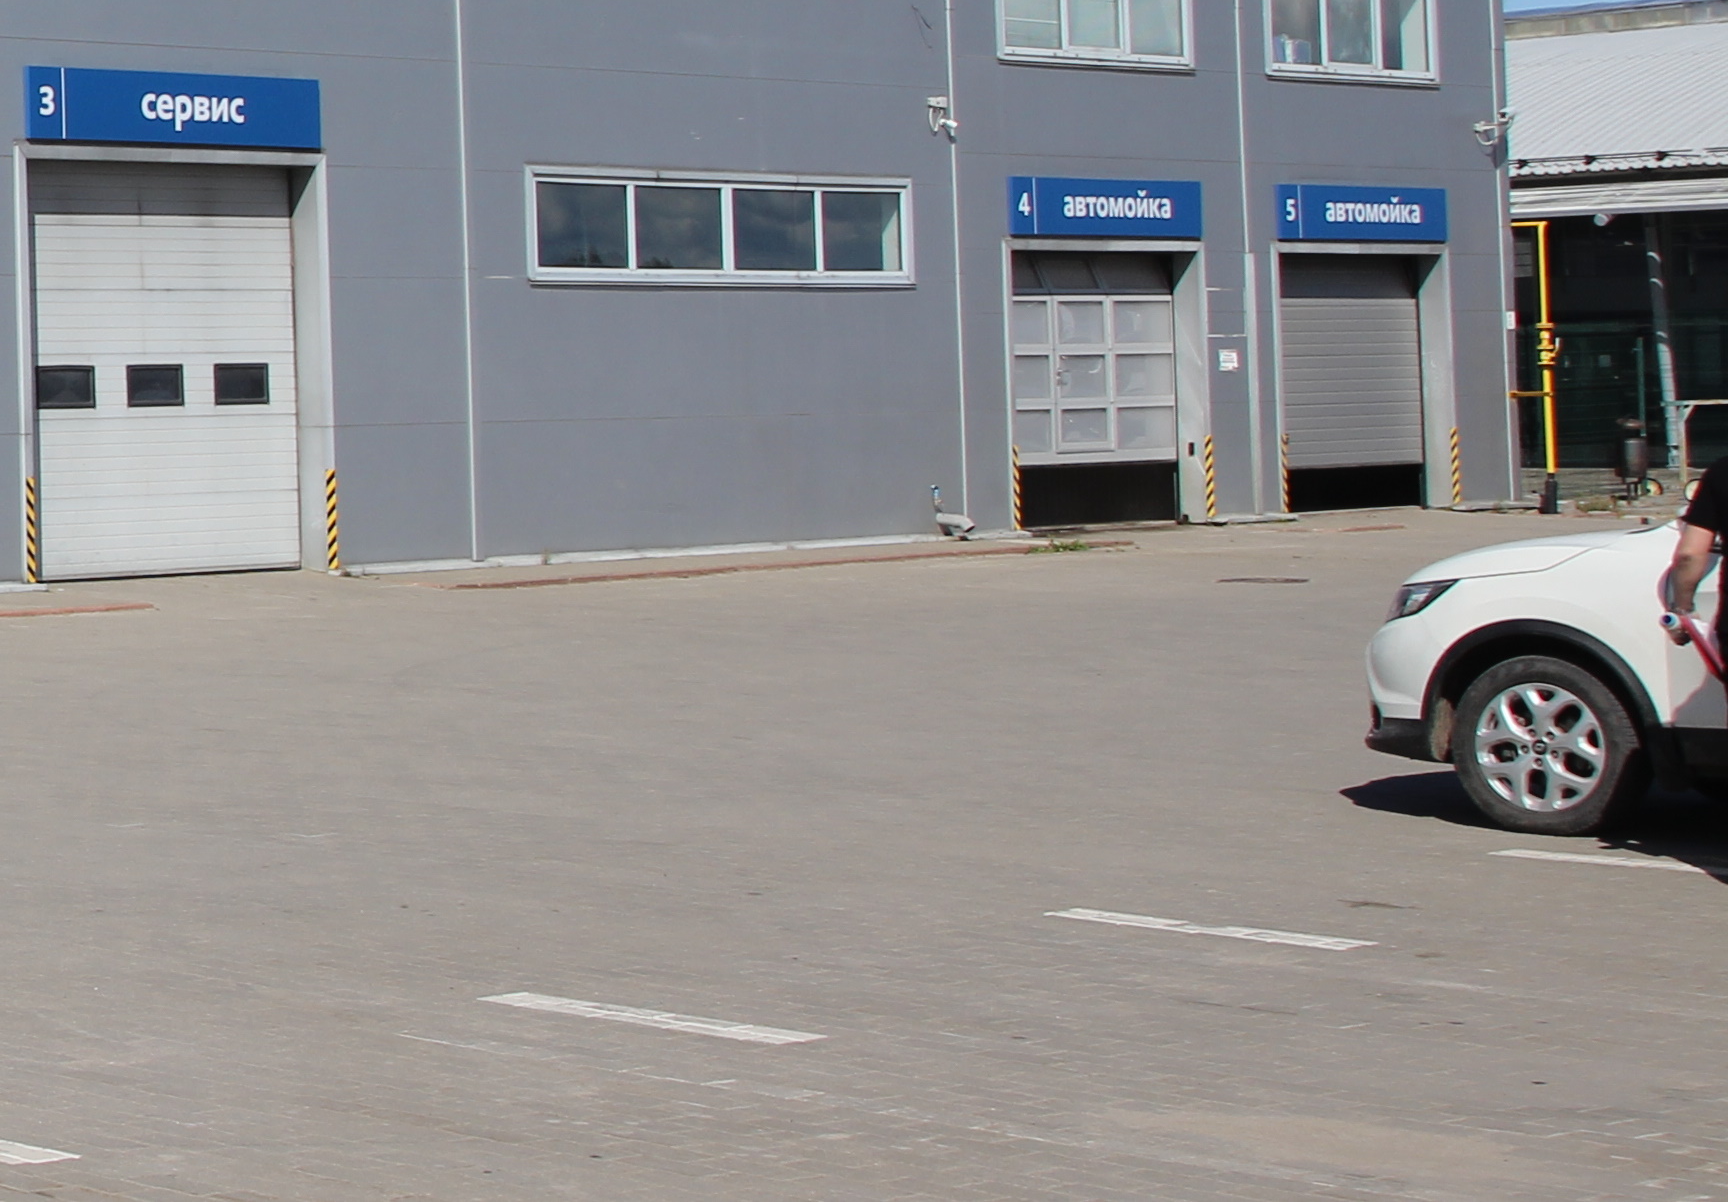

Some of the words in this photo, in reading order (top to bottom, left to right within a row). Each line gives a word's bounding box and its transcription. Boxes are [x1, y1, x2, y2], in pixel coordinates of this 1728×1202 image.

[39, 85, 56, 117] 3
[140, 92, 246, 131] сервис
[1017, 190, 1031, 217] 4
[1062, 188, 1172, 220] автомойка
[1285, 199, 1295, 222] 5
[1324, 195, 1422, 225] автомойка
